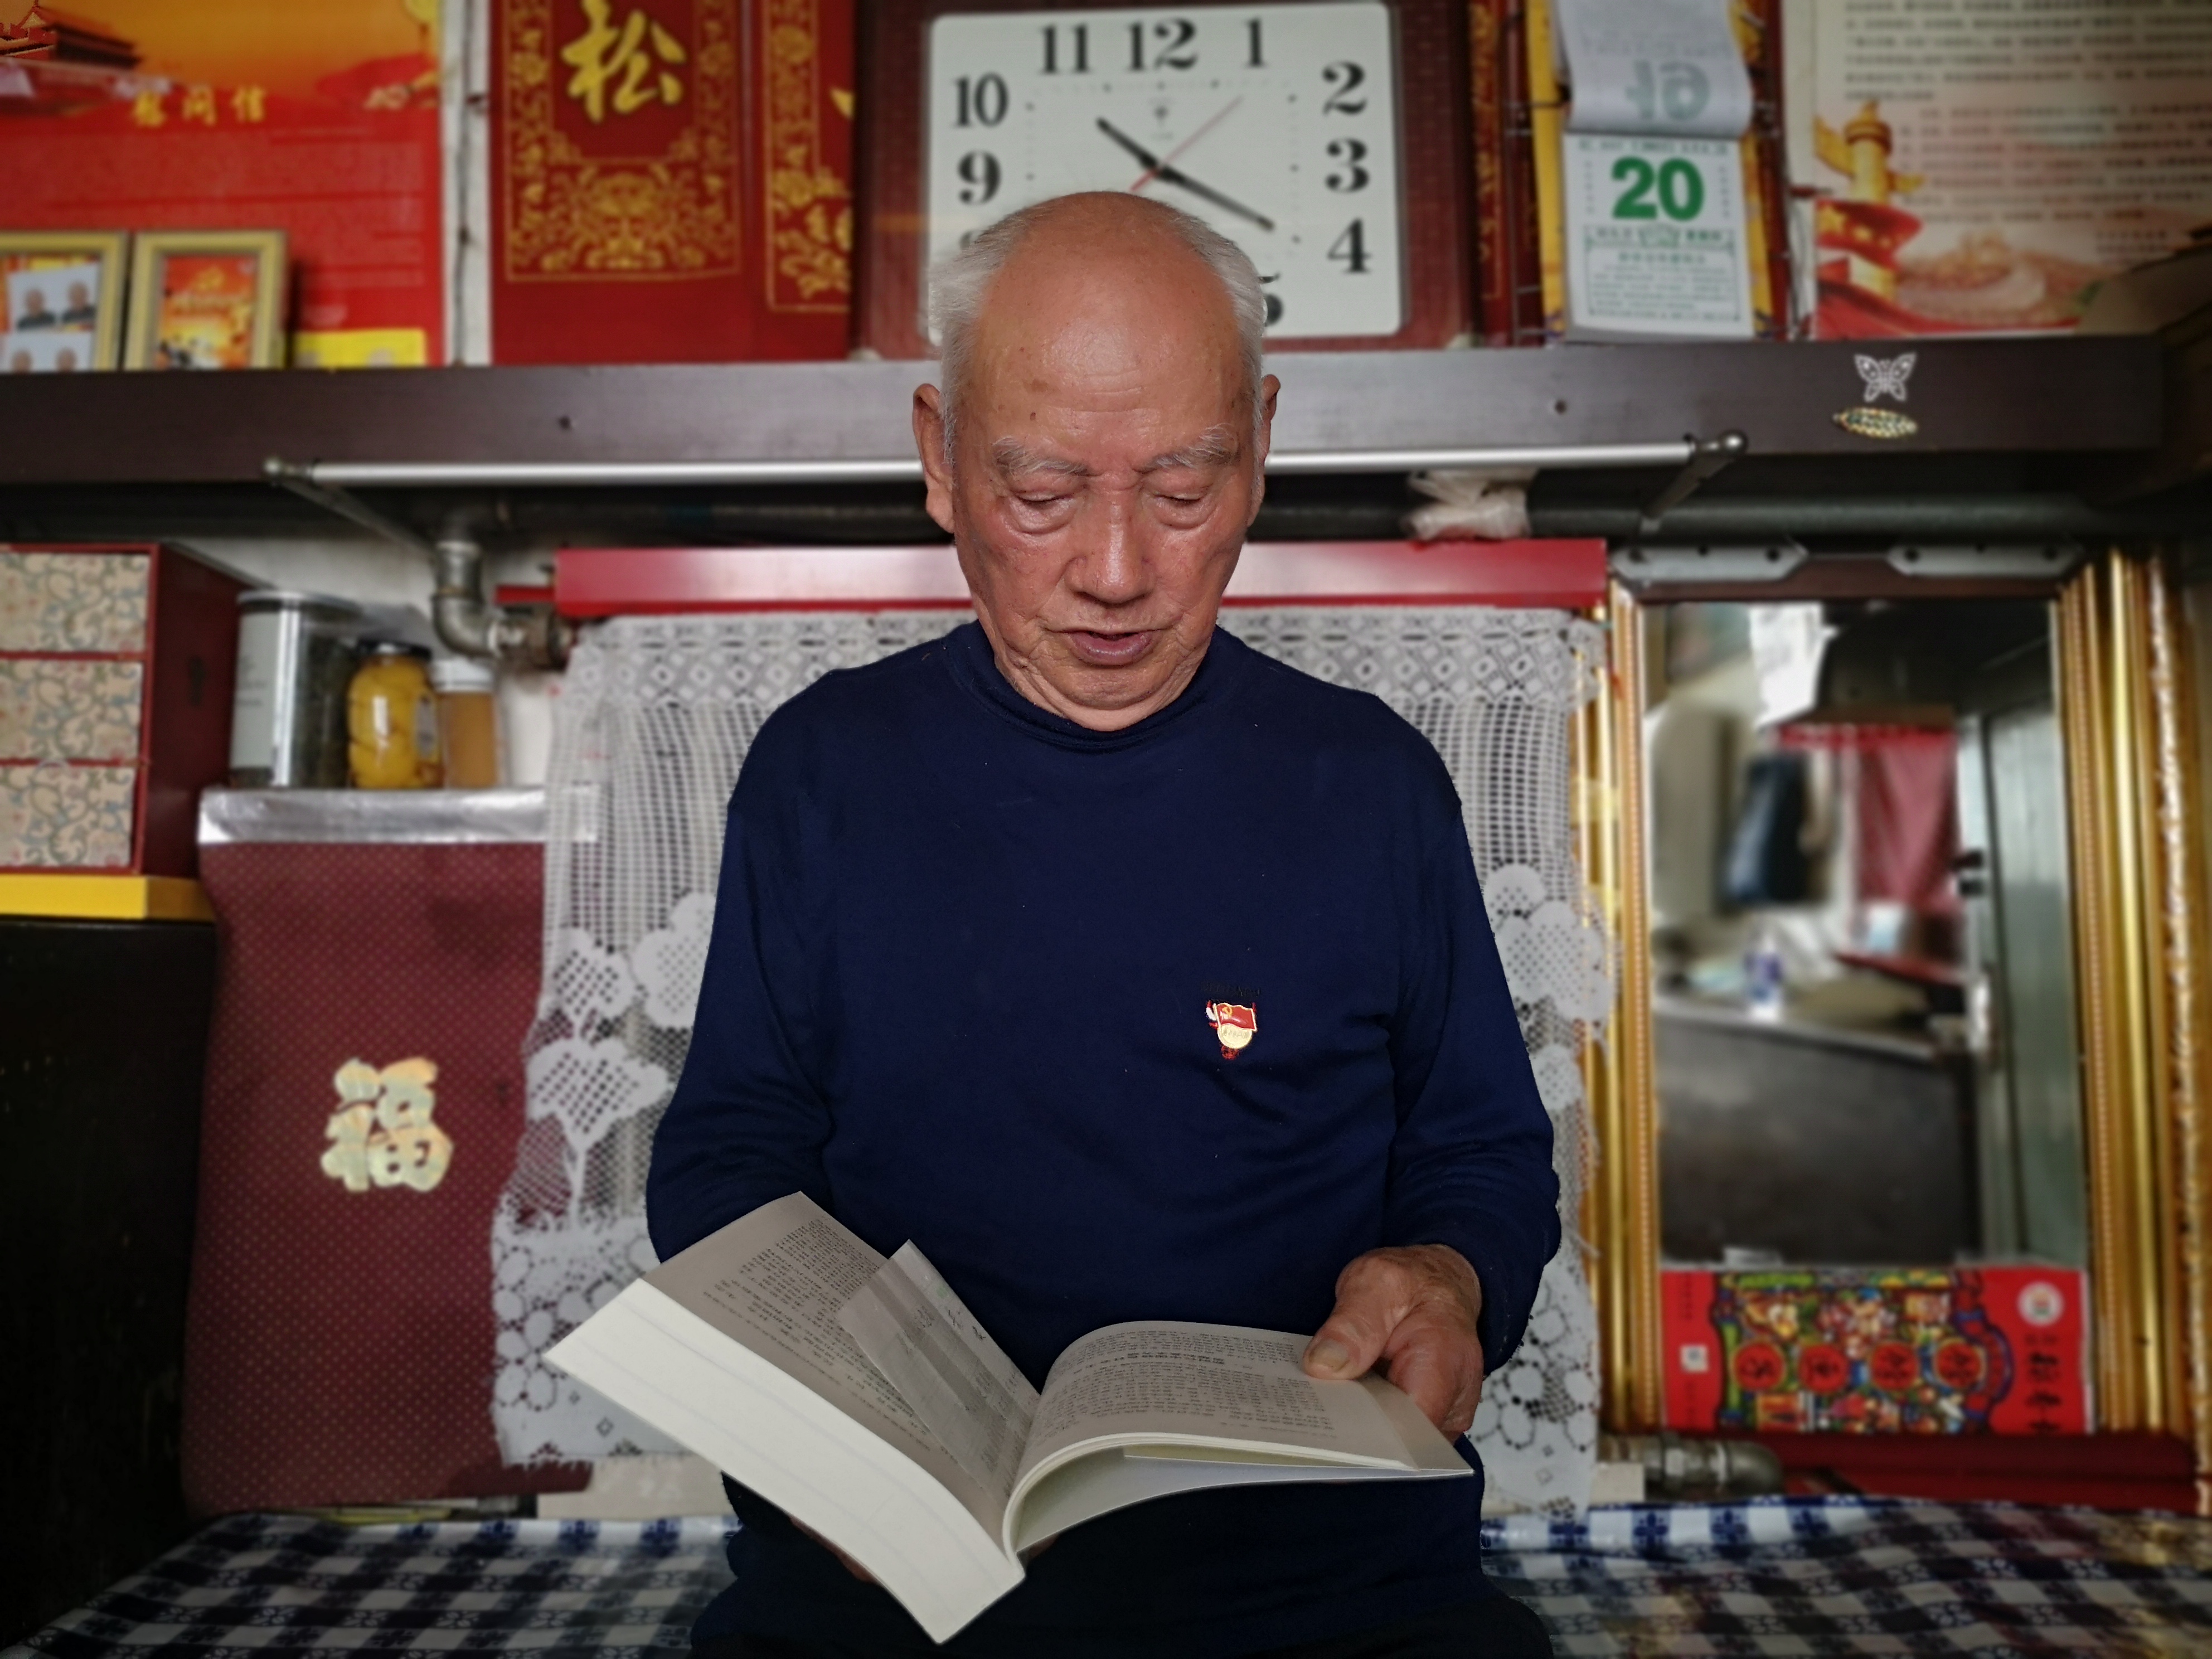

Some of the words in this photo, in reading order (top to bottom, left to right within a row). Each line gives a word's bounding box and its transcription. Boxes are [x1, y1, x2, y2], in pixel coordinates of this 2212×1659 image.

[561, 0, 686, 124] 松
[1039, 23, 1090, 75] 11
[1126, 18, 1197, 71] 12
[1243, 18, 1267, 68] 1
[952, 72, 1009, 128] 10
[1322, 61, 1367, 116] 2
[957, 151, 1002, 205] 9
[1325, 138, 1370, 192] 3
[1612, 157, 1705, 221] 20
[1326, 219, 1371, 274] 4
[320, 1058, 454, 1192] 福
